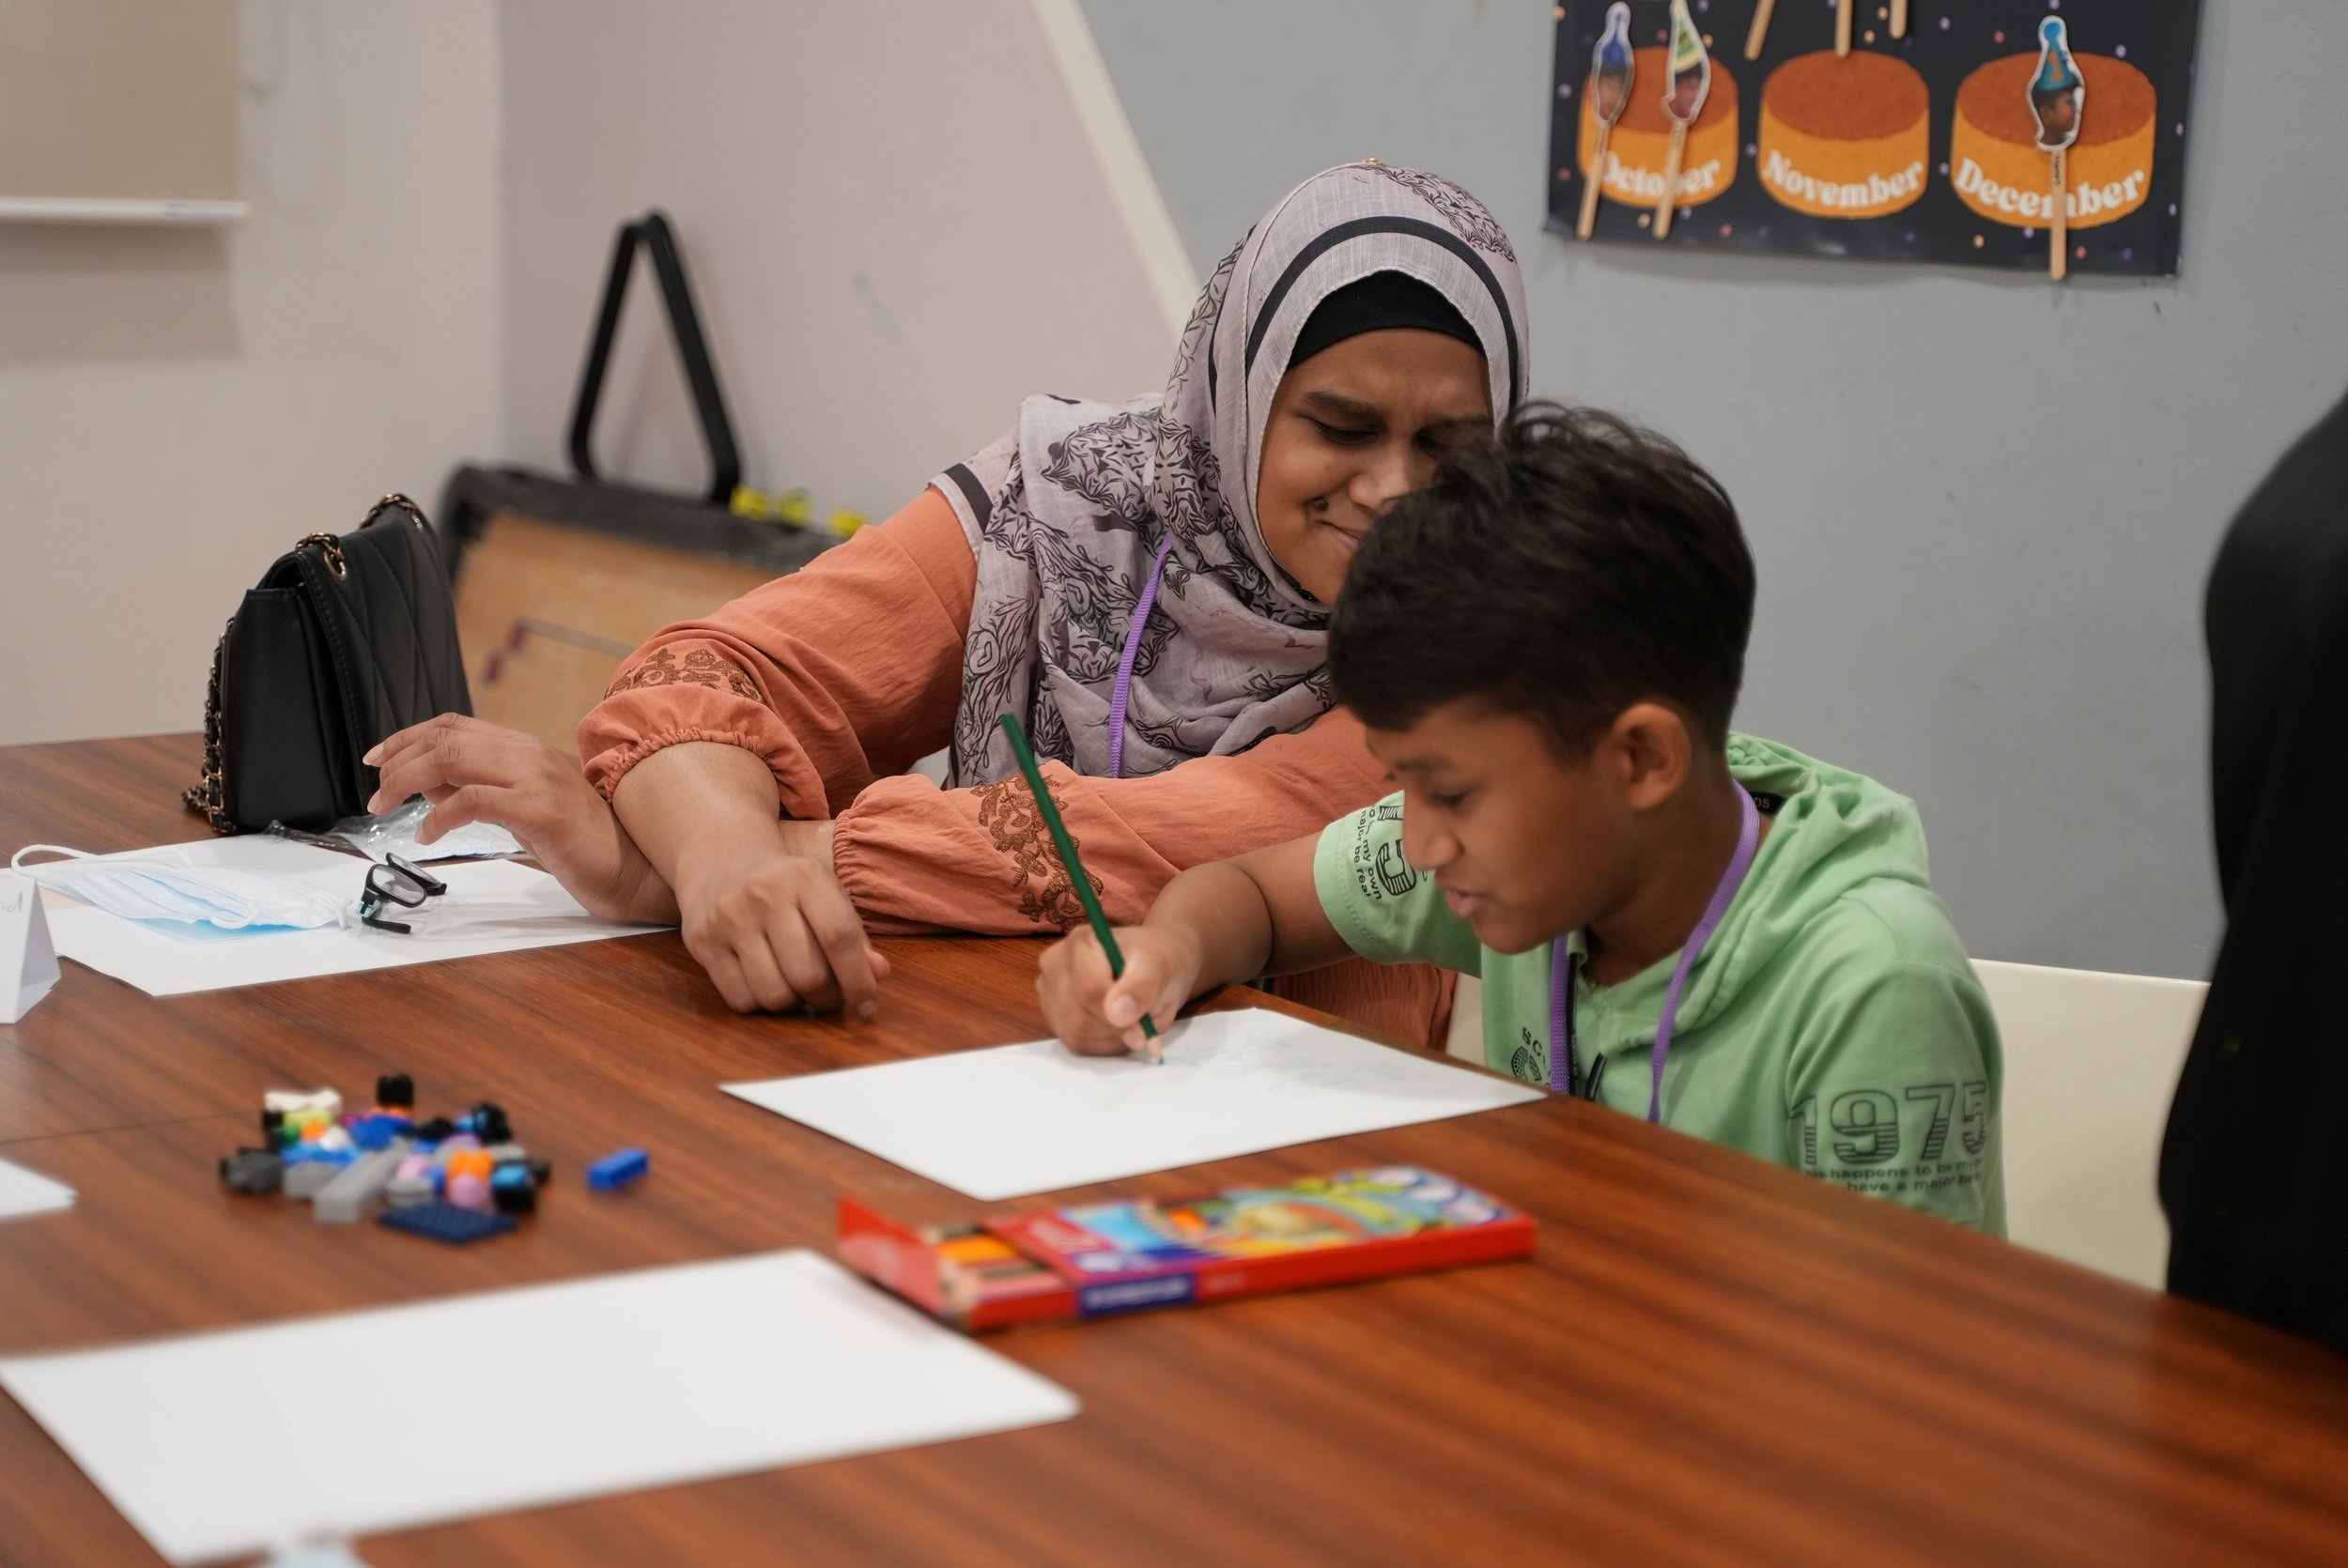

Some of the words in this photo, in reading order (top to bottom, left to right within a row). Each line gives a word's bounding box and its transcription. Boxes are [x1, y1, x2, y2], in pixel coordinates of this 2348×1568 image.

[1600, 150, 1722, 197] Octoer
[1761, 149, 1924, 208] November
[1955, 157, 2145, 218] December
[1353, 845, 1362, 864] be
[1363, 839, 1371, 862] my
[1367, 868, 1382, 899] own
[1787, 1080, 1988, 1164] 1975
[1831, 1165, 1909, 1179] happens
[1915, 1164, 1933, 1175] to
[1846, 1180, 1890, 1192] have
[1897, 1182, 1908, 1191] a
[1914, 1176, 1955, 1191] major
